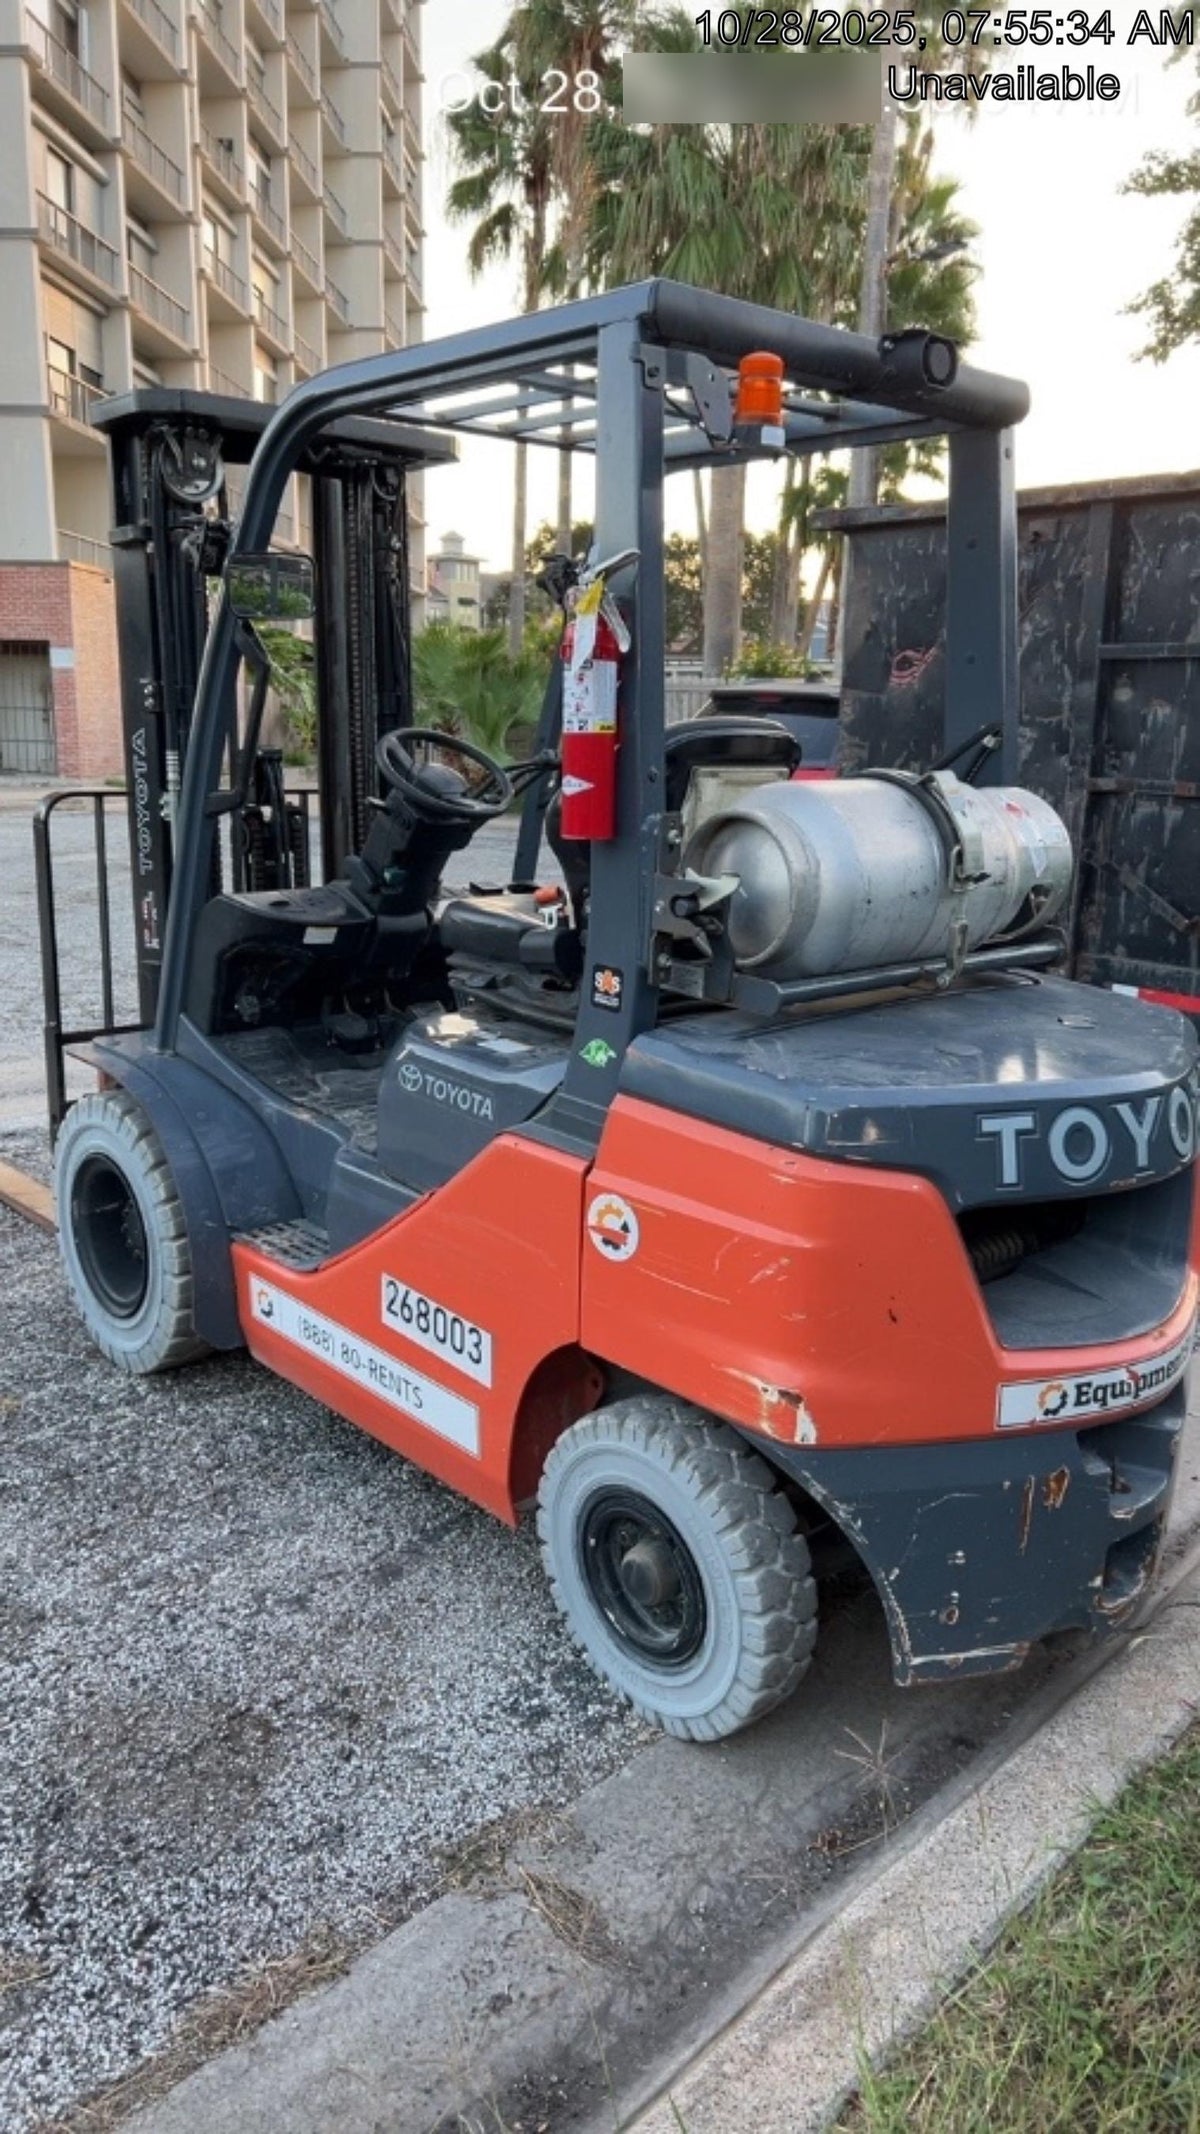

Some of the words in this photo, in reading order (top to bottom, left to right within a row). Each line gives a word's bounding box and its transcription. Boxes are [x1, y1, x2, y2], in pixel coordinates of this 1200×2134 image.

[132, 727, 154, 876] TOYOTA
[423, 1073, 495, 1121] TOYOTA
[975, 1080, 1199, 1189] TOYO
[298, 1315, 336, 1358] (888)
[341, 1341, 424, 1410] 80-RENTS
[384, 1279, 484, 1366] 268003
